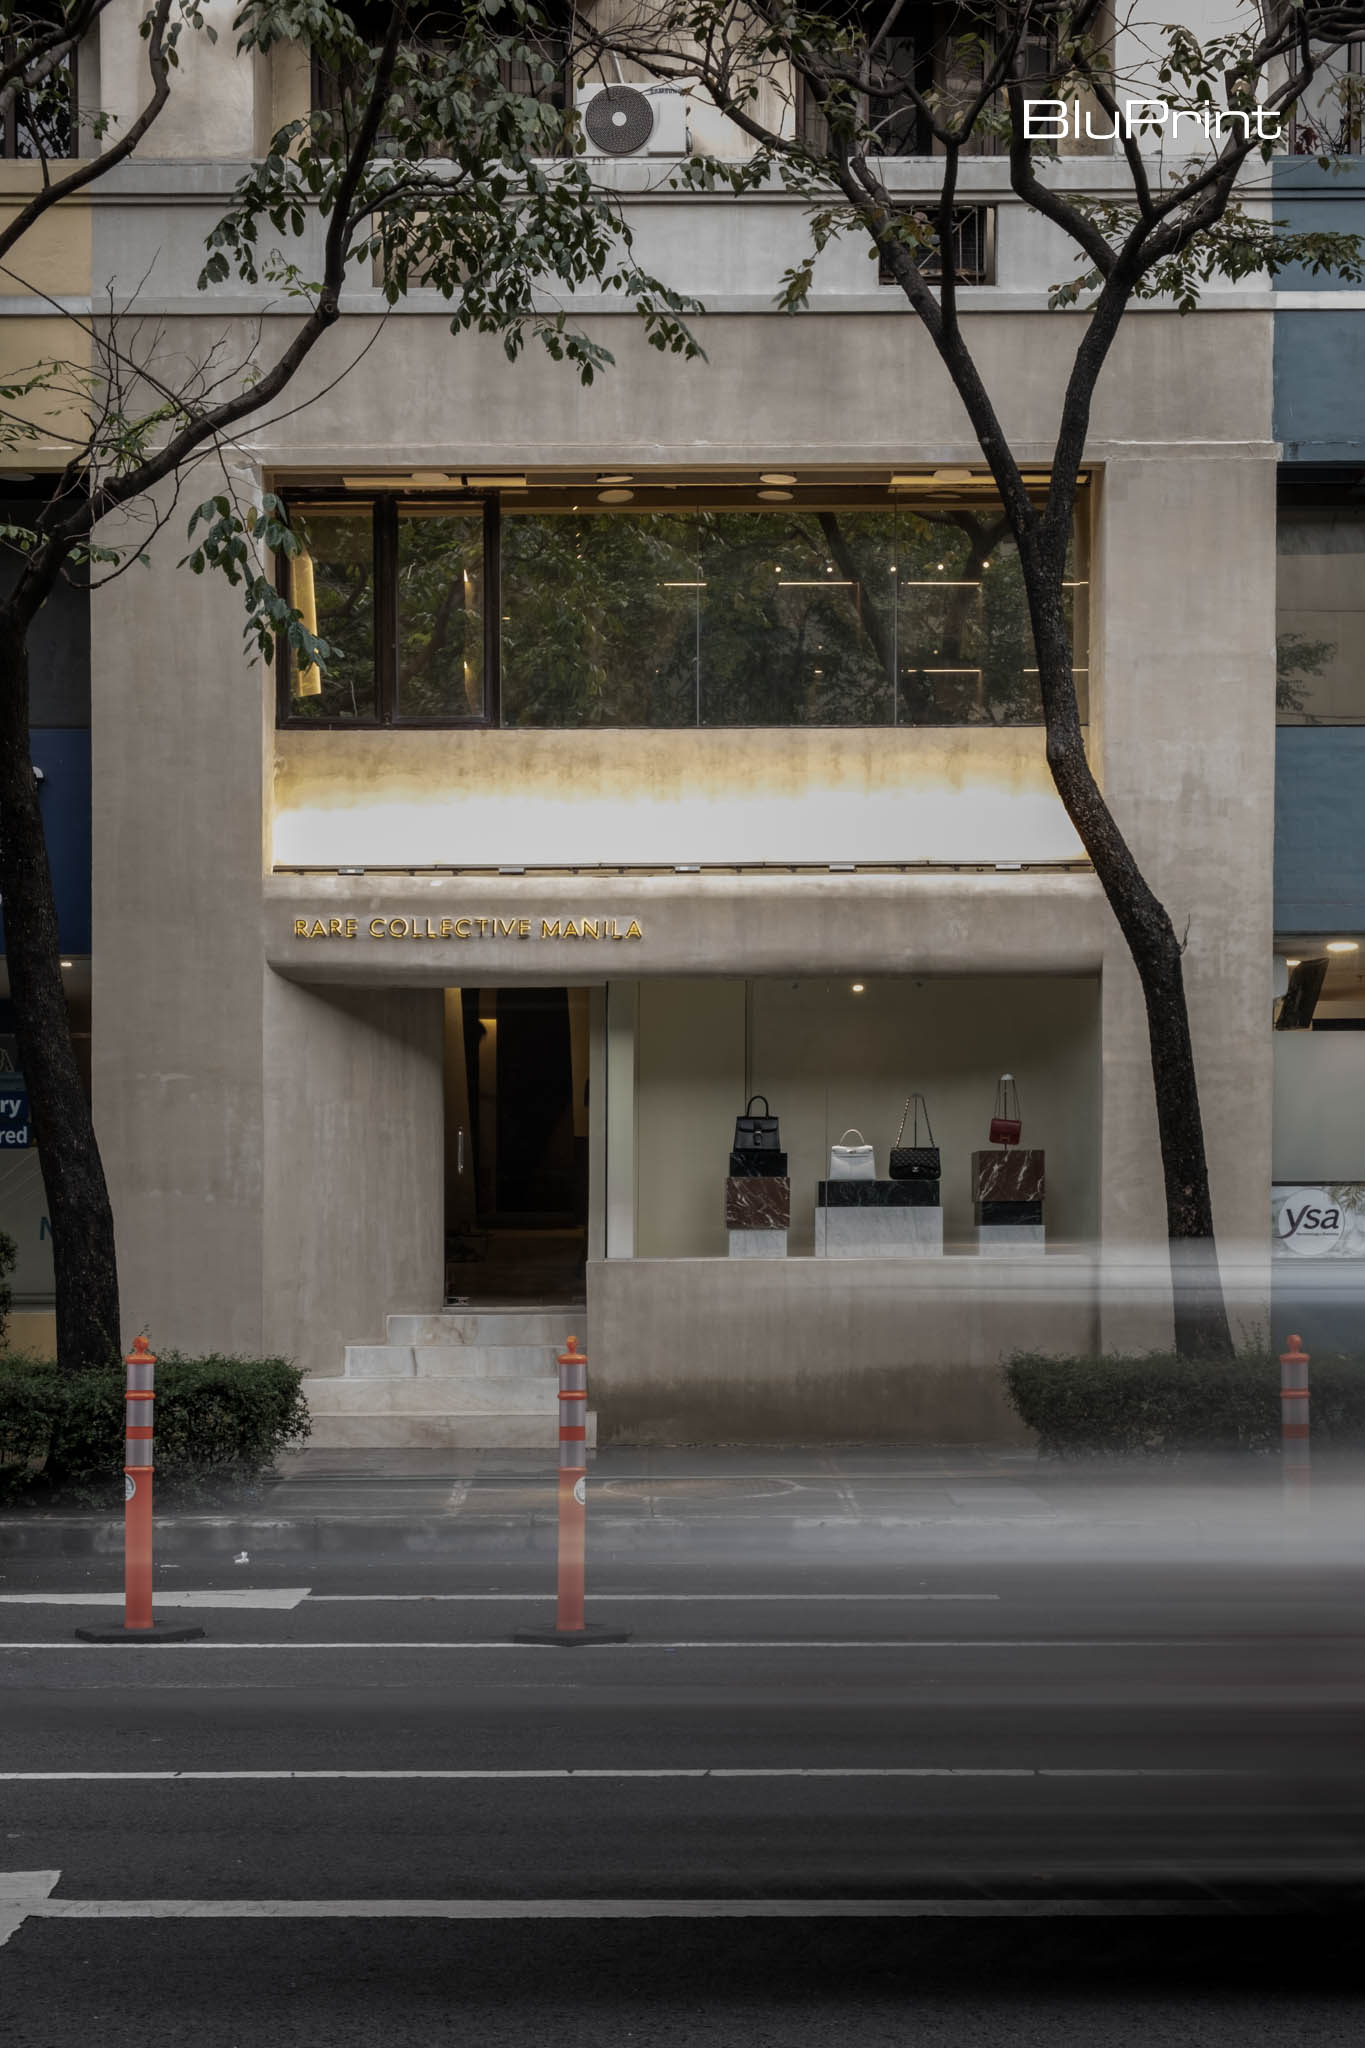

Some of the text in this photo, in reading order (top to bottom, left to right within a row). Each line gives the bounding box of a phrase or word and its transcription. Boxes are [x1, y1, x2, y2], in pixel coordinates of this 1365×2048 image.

[294, 918, 643, 941] RARE COLLECTIVE MANILA
[1272, 1205, 1340, 1239] ysa
